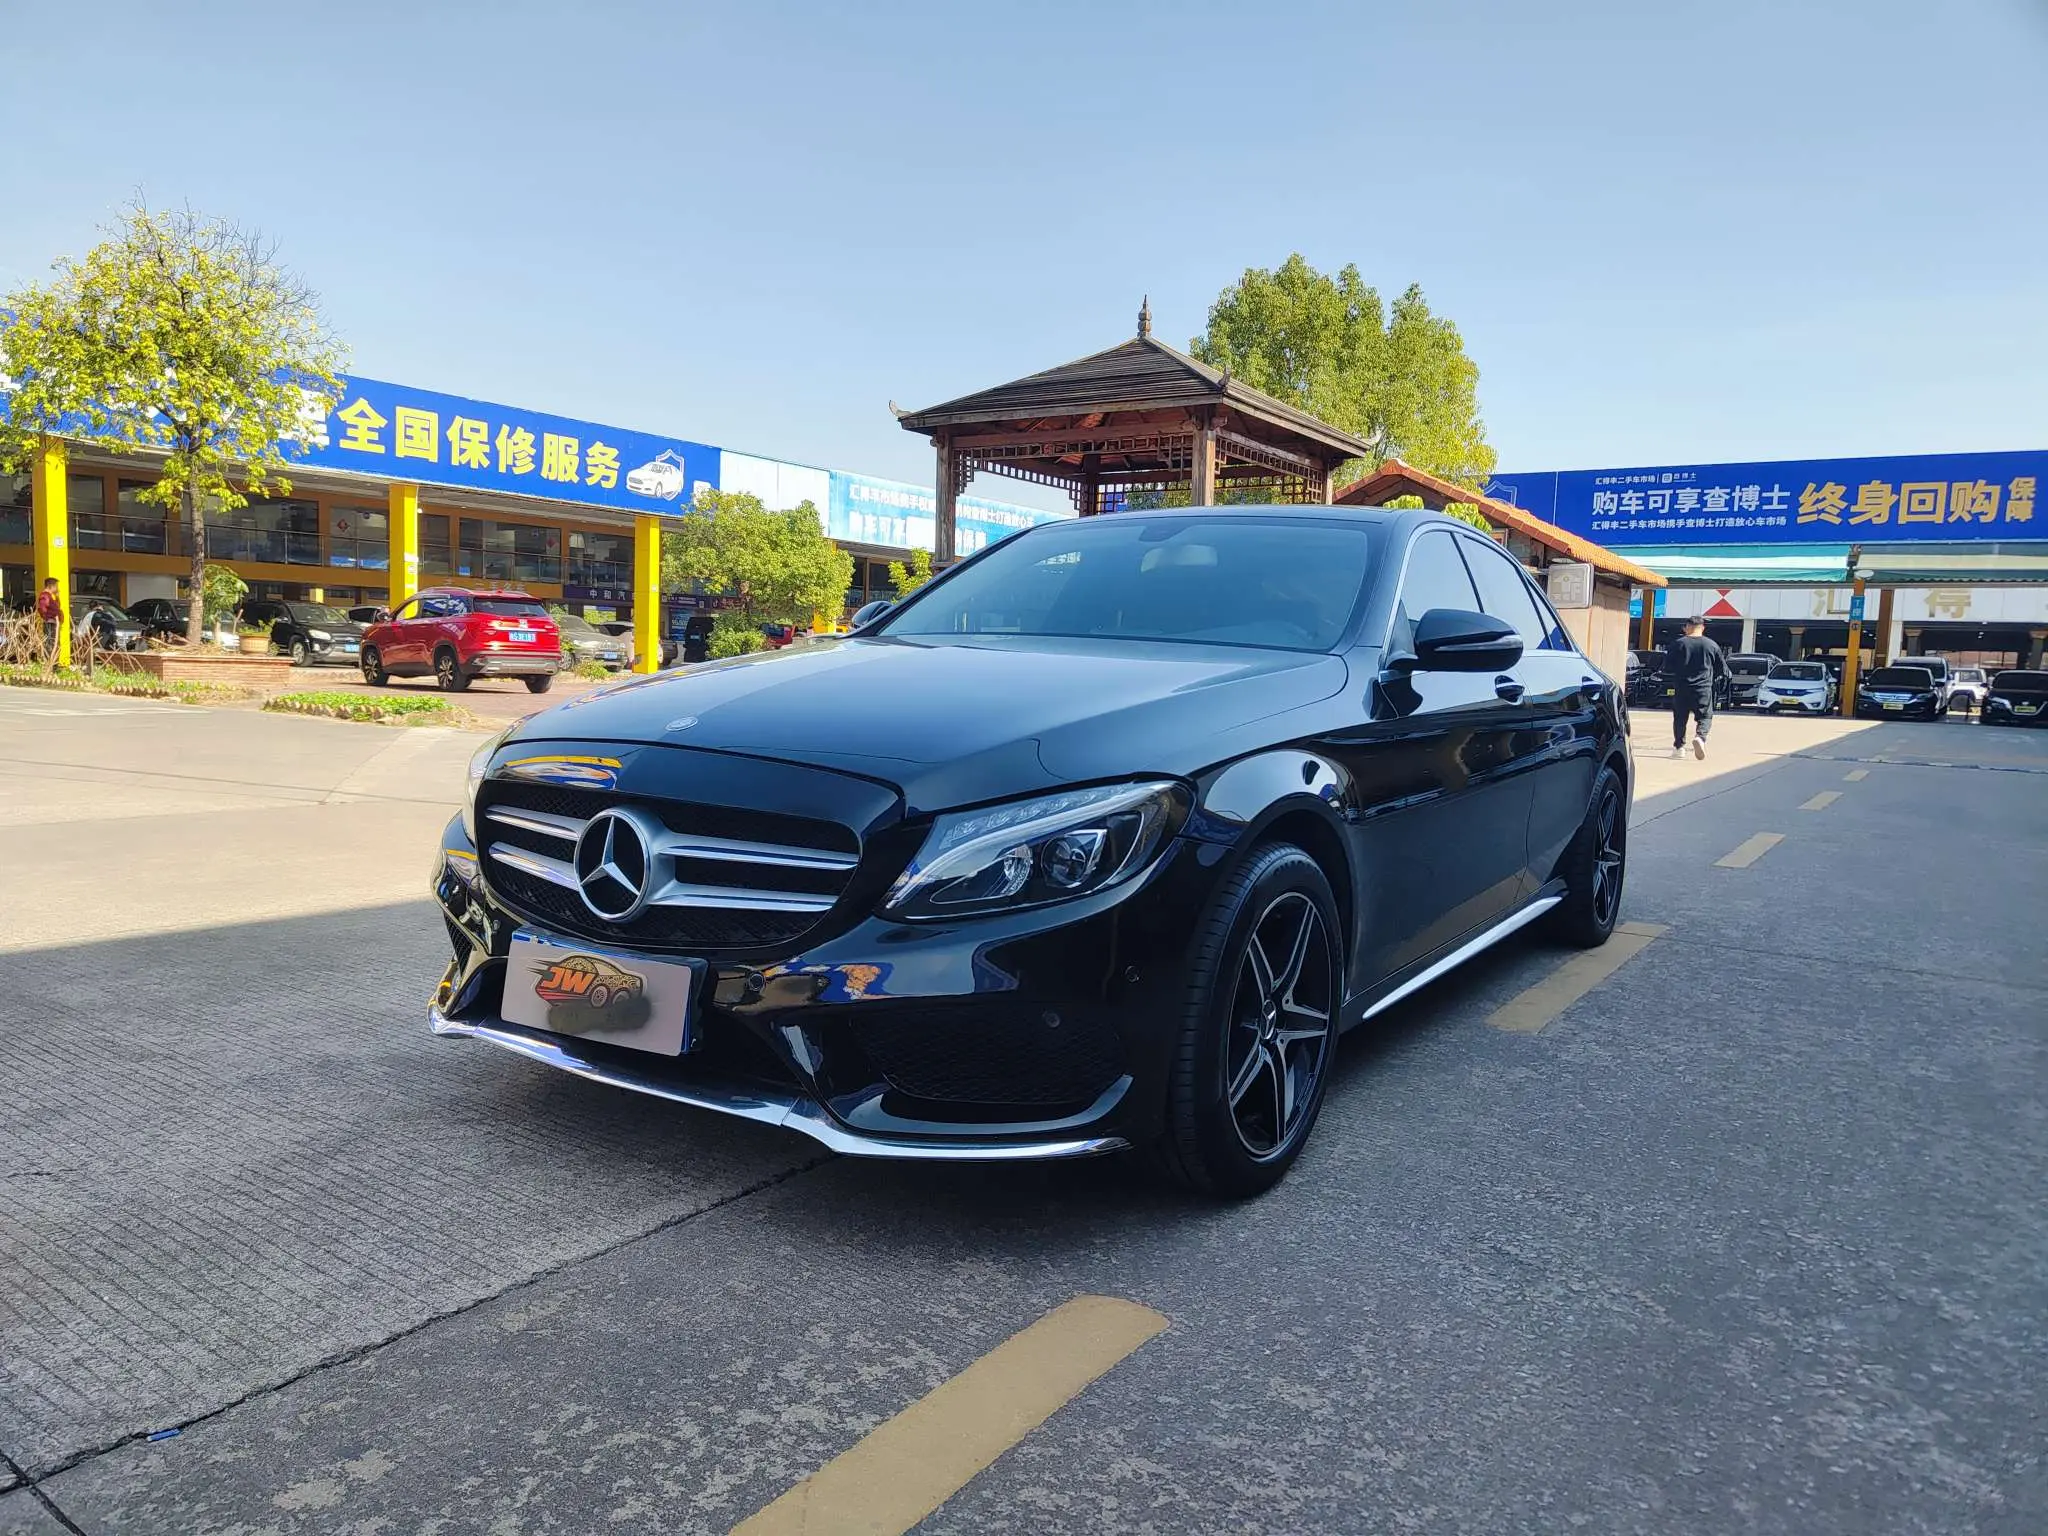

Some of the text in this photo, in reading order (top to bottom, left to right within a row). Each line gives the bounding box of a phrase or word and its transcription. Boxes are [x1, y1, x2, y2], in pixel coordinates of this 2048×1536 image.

[337, 397, 621, 488] 全国保修服务
[1592, 484, 1791, 516] 购车可享查博士
[1797, 479, 2001, 525] 终身回购
[542, 966, 597, 994] JW
